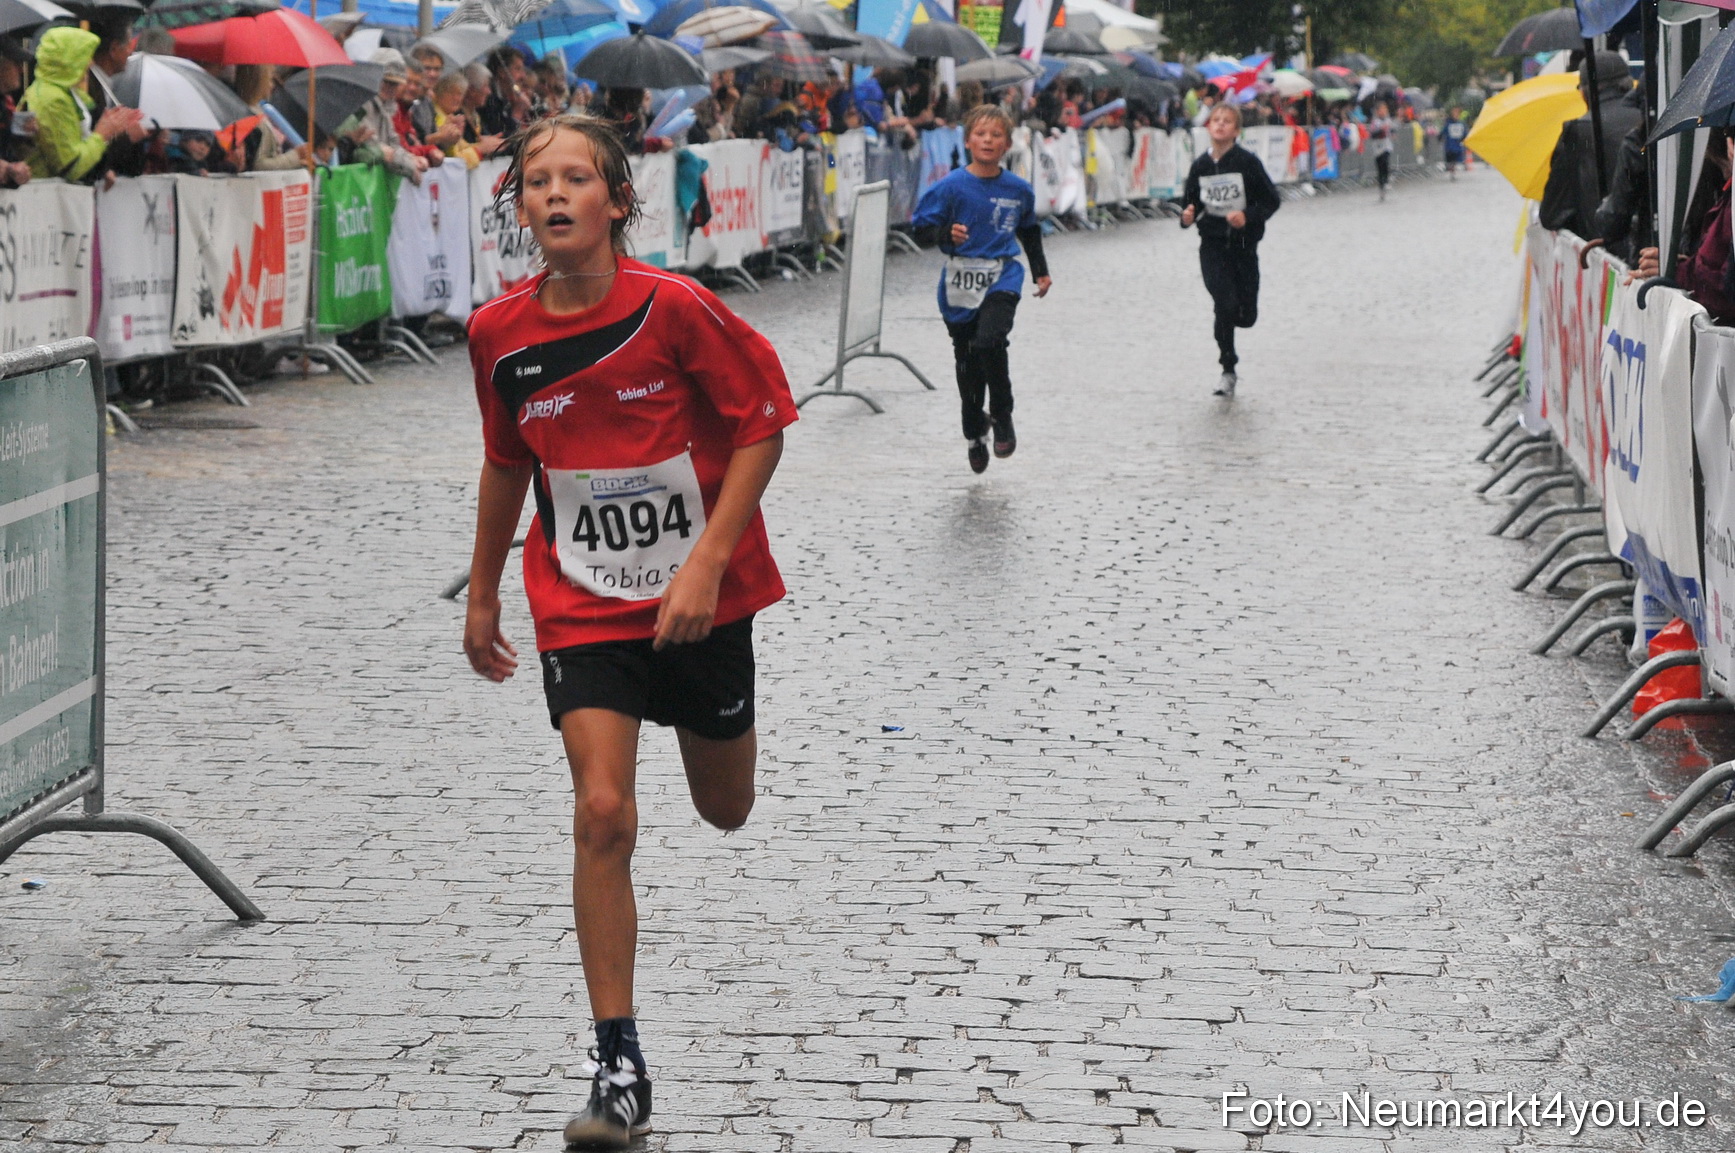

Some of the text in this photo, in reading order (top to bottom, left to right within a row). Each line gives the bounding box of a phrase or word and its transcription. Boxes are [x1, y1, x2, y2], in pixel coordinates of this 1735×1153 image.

[1206, 183, 1241, 203] 4023
[523, 364, 542, 376] JAKO
[616, 379, 665, 402] Tobias List
[520, 398, 554, 425] JURA
[590, 475, 651, 492] BOCK
[572, 493, 692, 552] 4094
[38, 533, 49, 592] in
[586, 563, 681, 590] Tobias
[9, 614, 59, 693] Bahnen!
